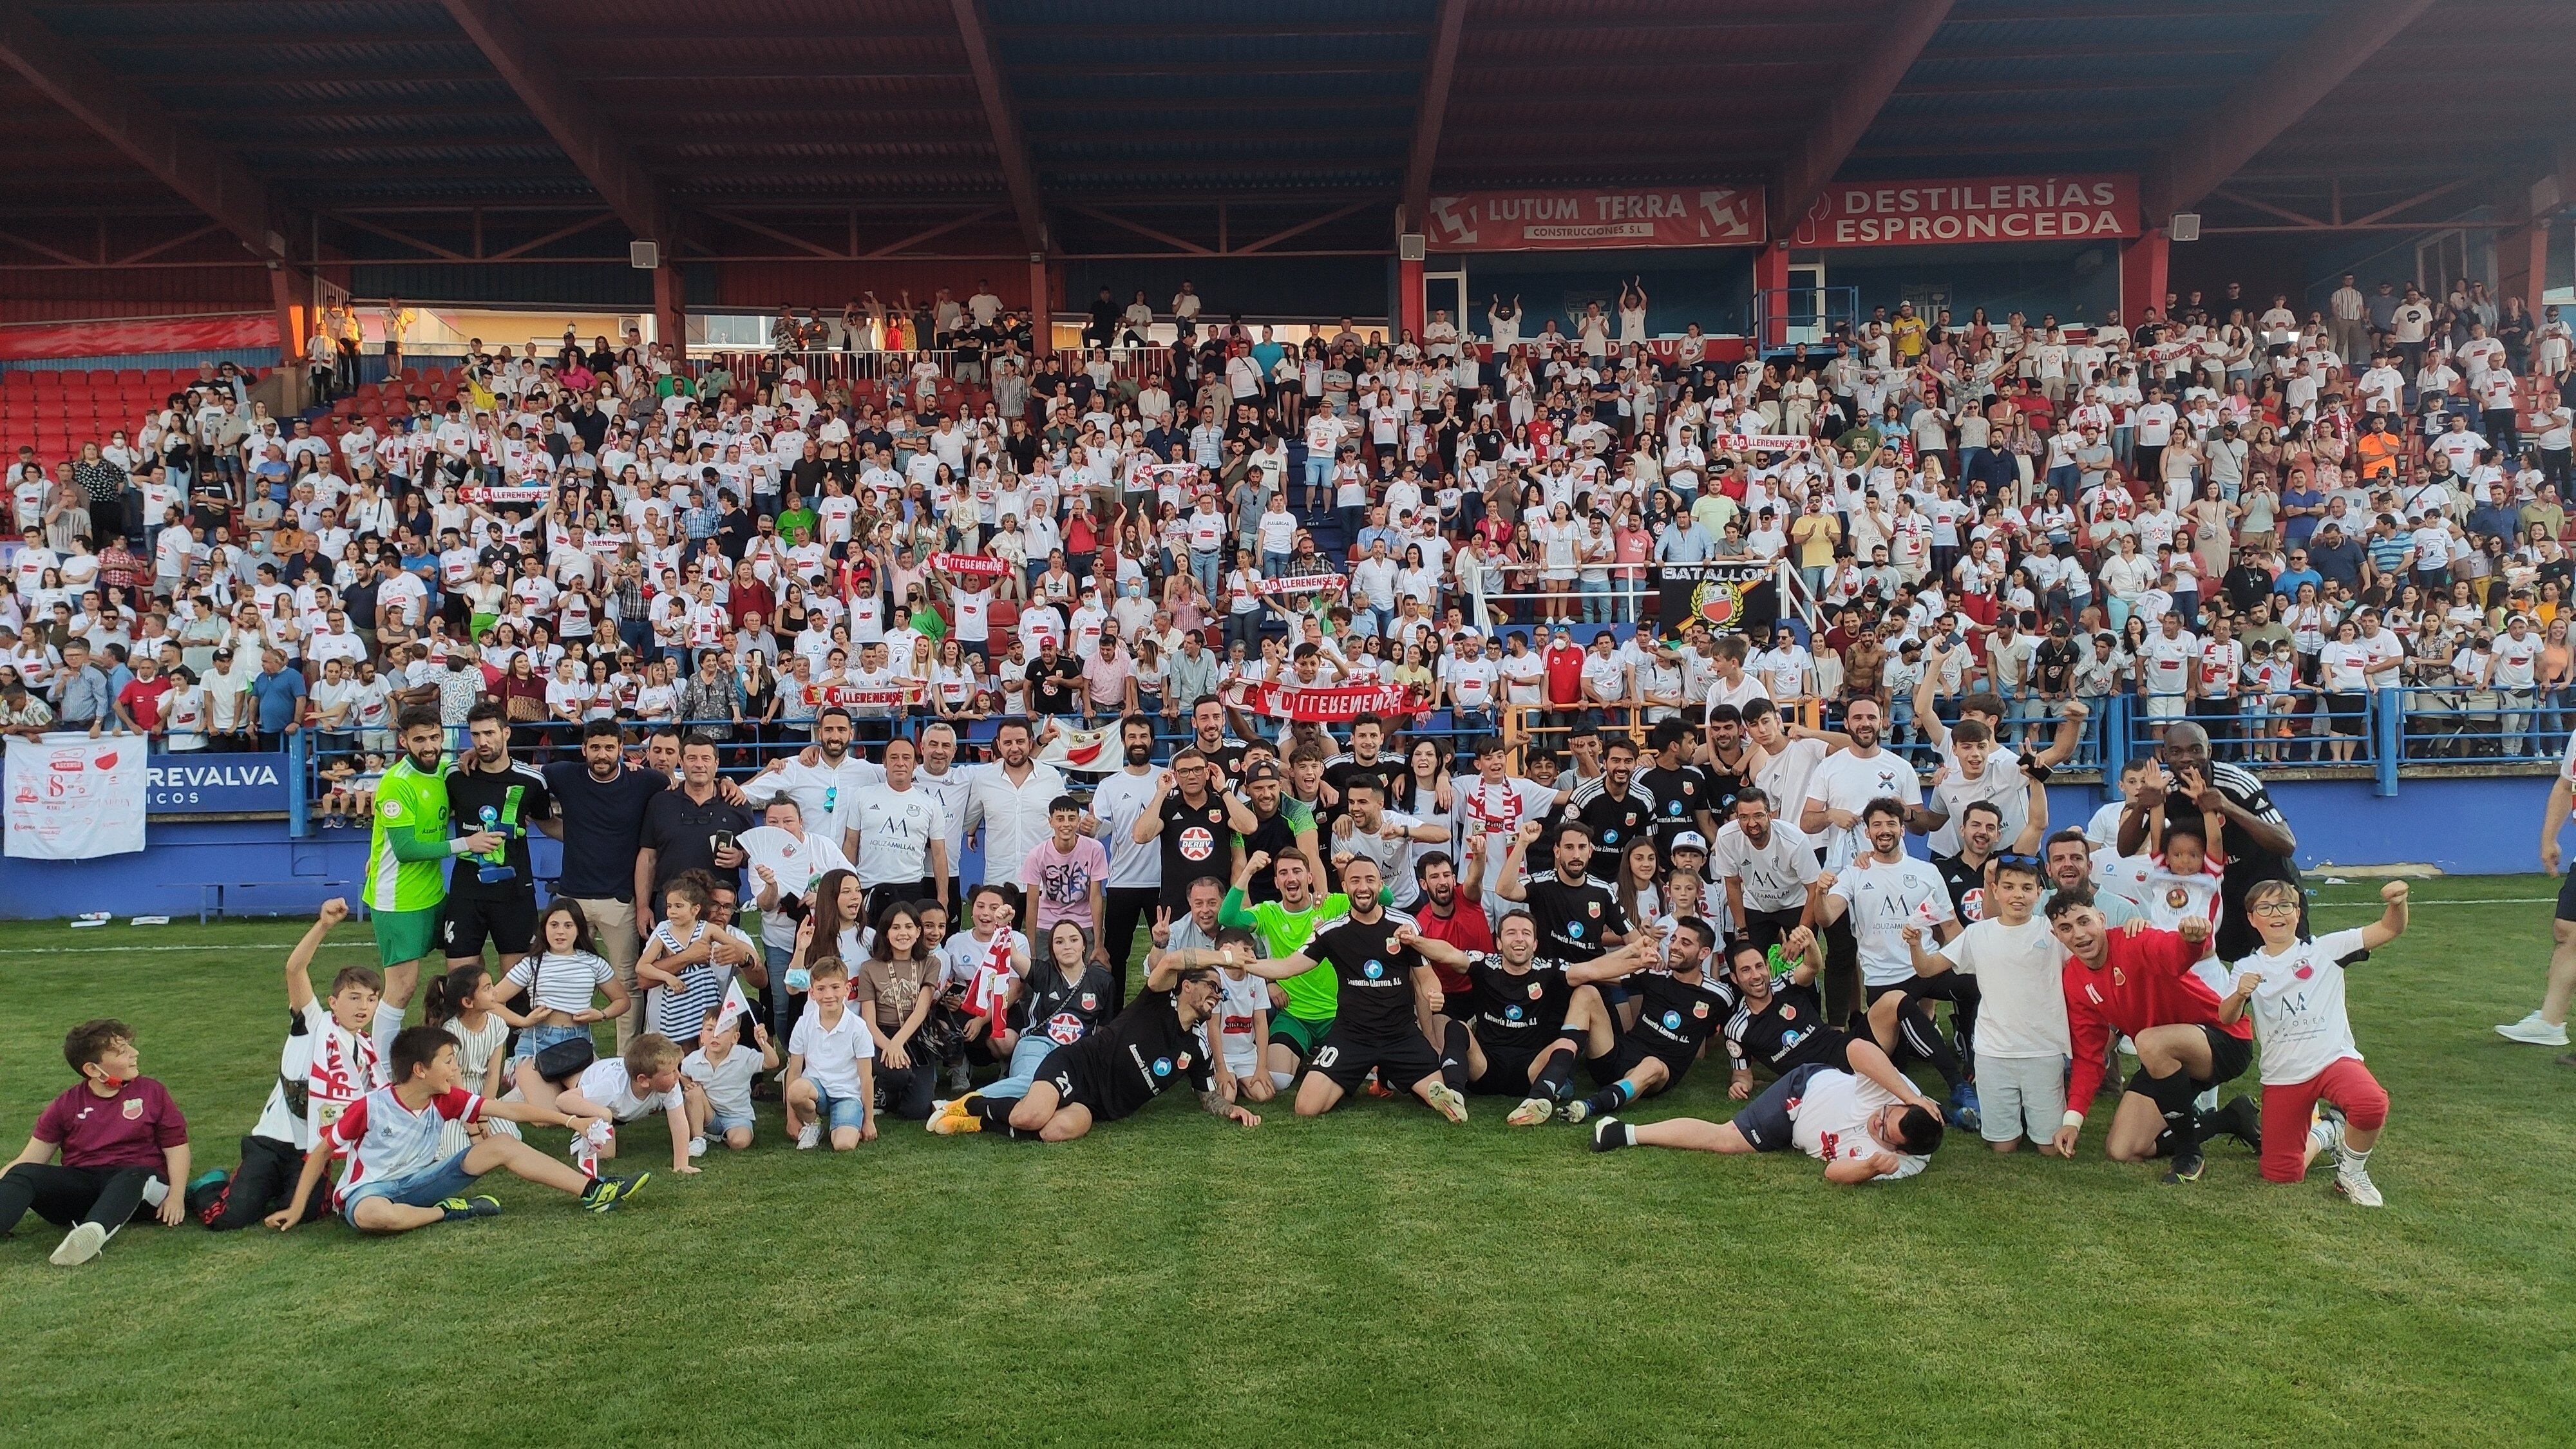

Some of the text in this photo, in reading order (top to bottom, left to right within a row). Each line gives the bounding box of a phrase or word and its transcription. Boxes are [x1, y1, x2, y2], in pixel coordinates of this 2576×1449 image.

[1844, 178, 2116, 214] DESTILERÍAS
[1488, 194, 1688, 221] LUTUM TERRA
[1533, 225, 1624, 238] CONSTRUCCIONES
[1836, 210, 2123, 243] ESPRONCEDA
[1748, 439, 1792, 450] LLERENENSE
[493, 489, 542, 500] LLERENENSE
[1662, 566, 1773, 582] BATALLON
[1280, 575, 1332, 590] LLERENENSE
[146, 764, 279, 787] REVALVA
[147, 791, 199, 804] ICOS
[1965, 902, 1982, 911] DER
[1311, 1046, 1338, 1068] 20
